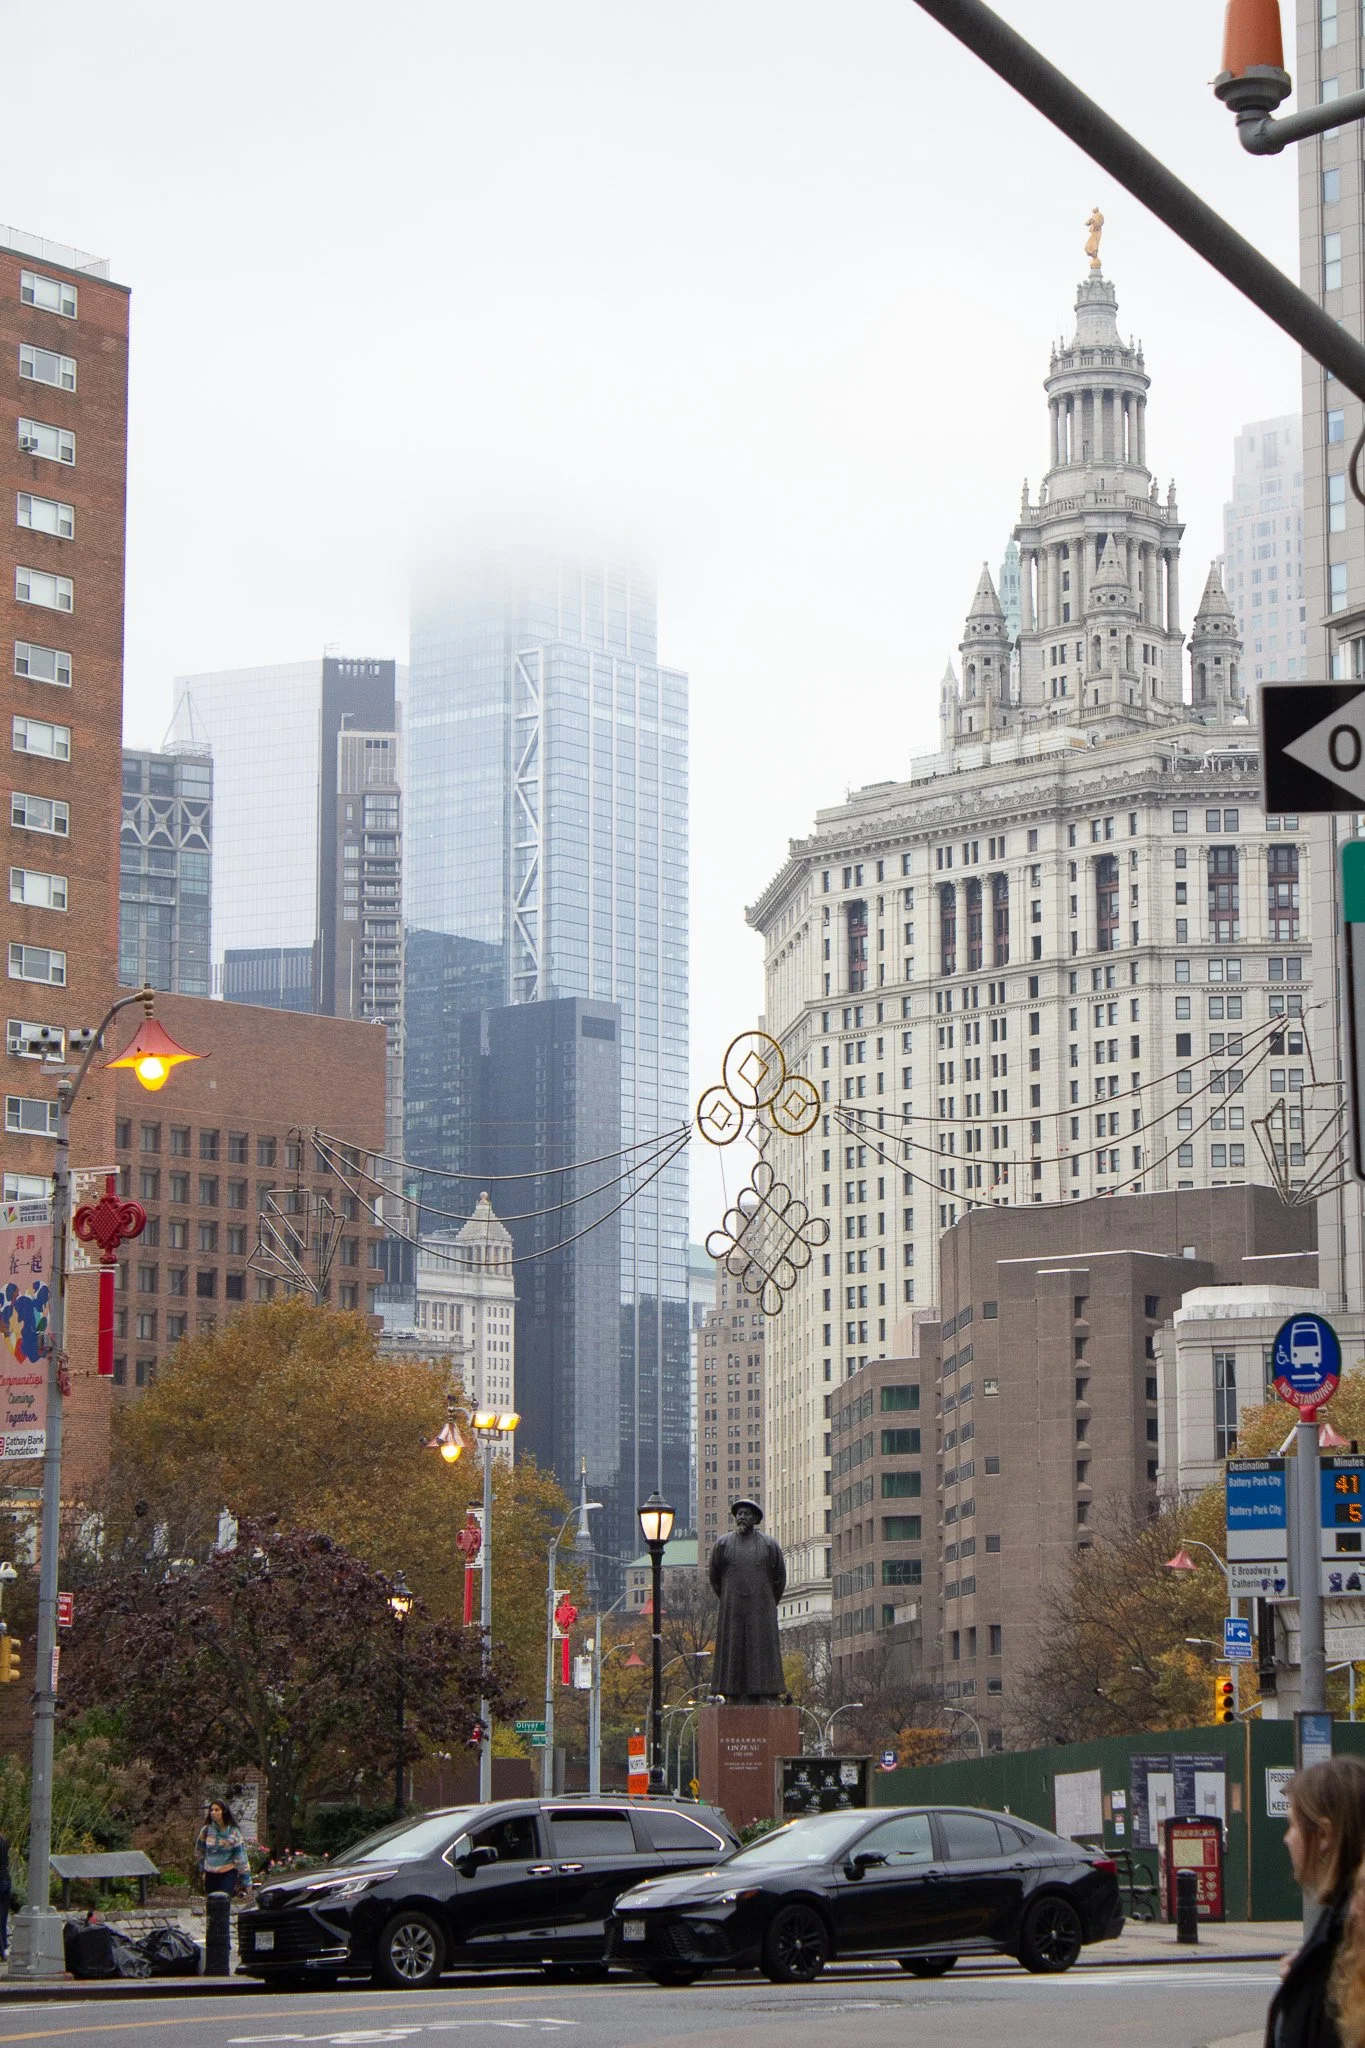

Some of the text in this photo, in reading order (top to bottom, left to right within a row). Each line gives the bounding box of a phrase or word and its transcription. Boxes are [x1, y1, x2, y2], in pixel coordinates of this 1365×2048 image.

[16, 1234, 35, 1249] 我們
[9, 1253, 42, 1275] 在一起
[1279, 1380, 1334, 1405] NO STANDING
[8, 1392, 35, 1408] Coming
[5, 1410, 38, 1427] Together
[6, 1435, 44, 1447] Cathay Bank
[5, 1446, 38, 1456] Foundation
[1229, 1461, 1269, 1471] Destination
[1333, 1457, 1364, 1467] Minutes
[1229, 1475, 1281, 1488] Battery Park City
[1335, 1475, 1359, 1494] 41
[1229, 1504, 1282, 1517] Battery Park City
[1349, 1503, 1362, 1522] 5
[1232, 1565, 1278, 1576] E Broadway &
[1232, 1578, 1264, 1589] Catherin
[1270, 1773, 1296, 1783] PEDEST
